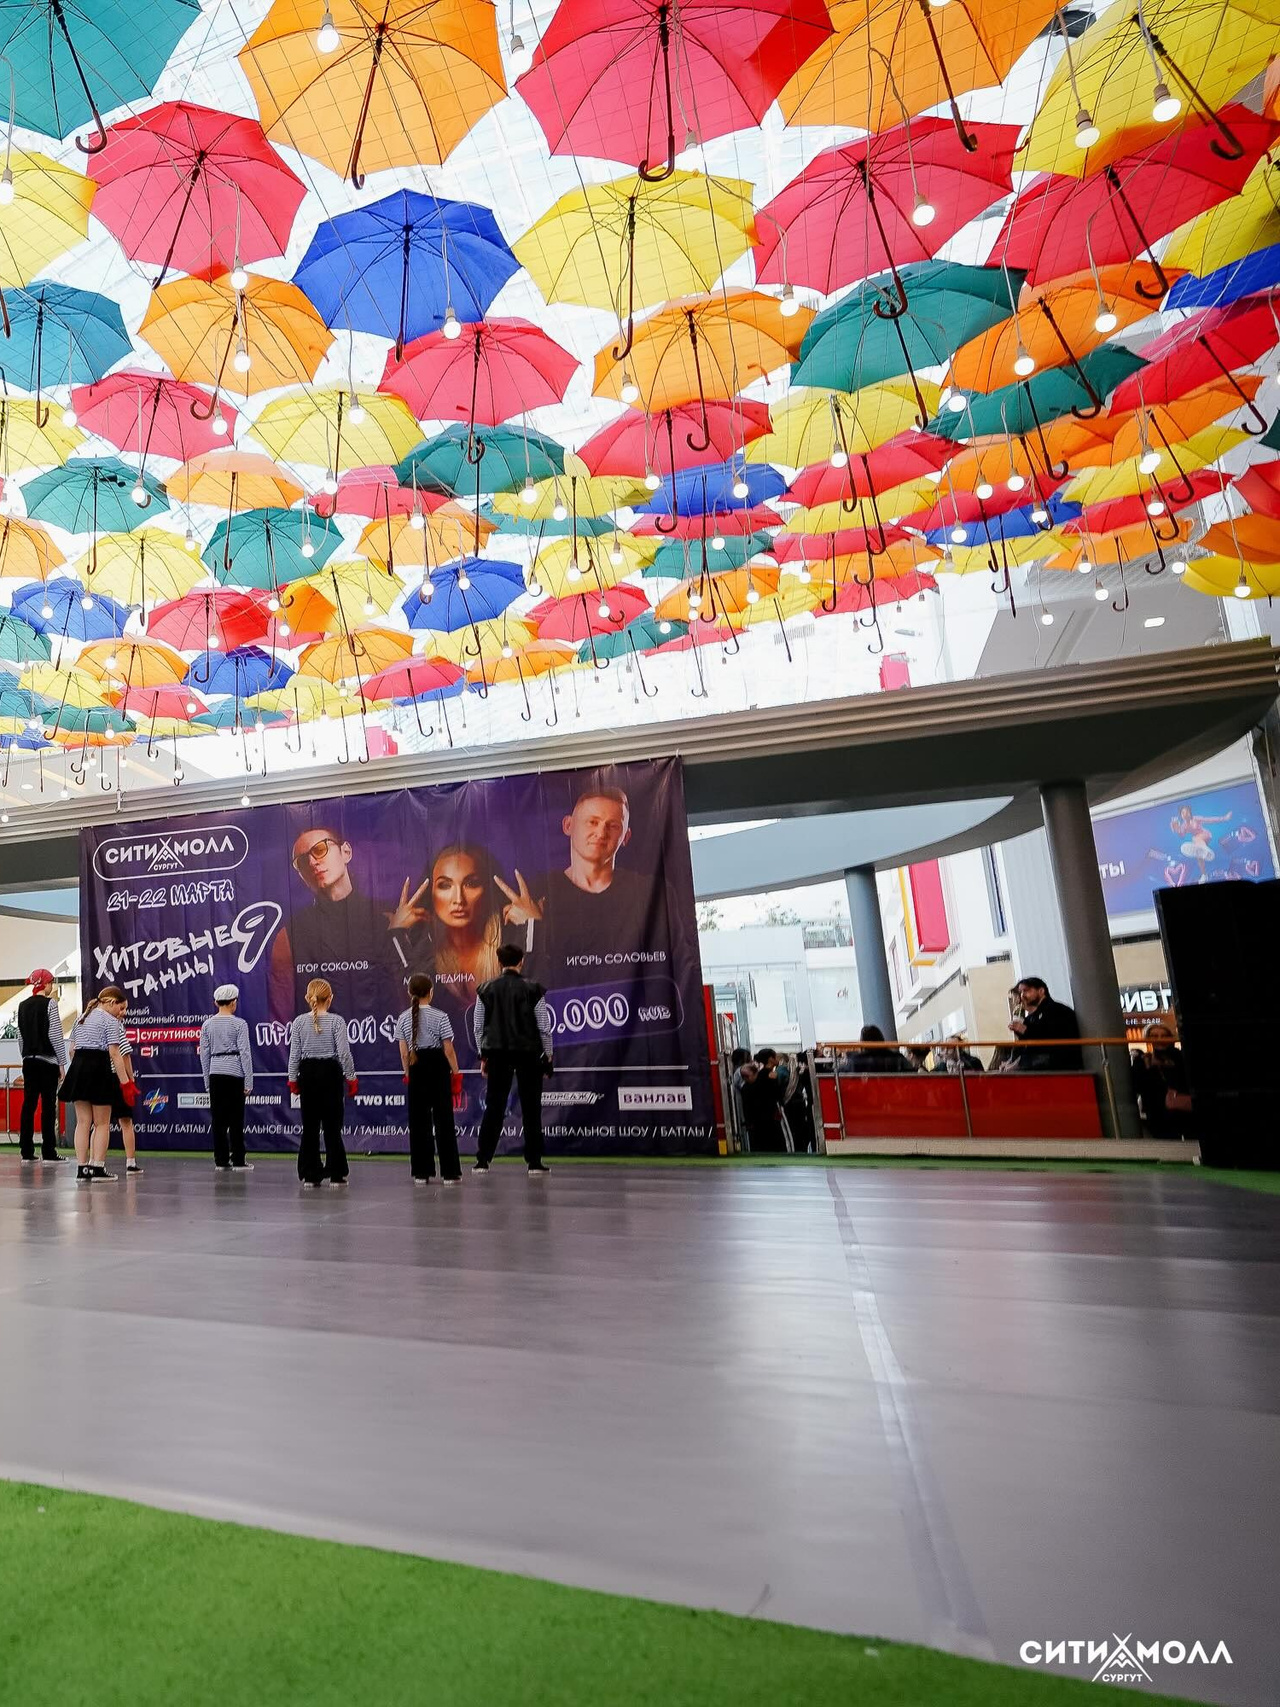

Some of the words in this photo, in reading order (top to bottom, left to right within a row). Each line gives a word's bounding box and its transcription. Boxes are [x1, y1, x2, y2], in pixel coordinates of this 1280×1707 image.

[153, 862, 179, 871] СУРГУТ
[1099, 861, 1125, 880] ТЫ
[106, 886, 167, 912] 21-22
[170, 879, 235, 906] МАРТА
[566, 955, 602, 967] ИГОРЬ
[604, 951, 667, 965] СОЛОВЬЕВ
[296, 963, 319, 974] ЕГОР
[321, 960, 369, 973] СОКОЛОВ
[435, 973, 475, 984] РЕДИНА
[140, 1029, 201, 1041] СУРГУТИНФО
[245, 1095, 282, 1105] AMAGUCHI
[354, 1095, 382, 1106] TWO
[623, 1093, 687, 1104] ванлав
[147, 1123, 168, 1134] ШОУ
[175, 1123, 205, 1134] БАТТЛЫ
[360, 1124, 410, 1136] ТАНЦЕВАЛ
[542, 1125, 616, 1138] НЦЕВАЛЬНОЕ
[620, 1125, 648, 1138] ШОУ
[660, 1125, 705, 1138] БАТТЛЫ
